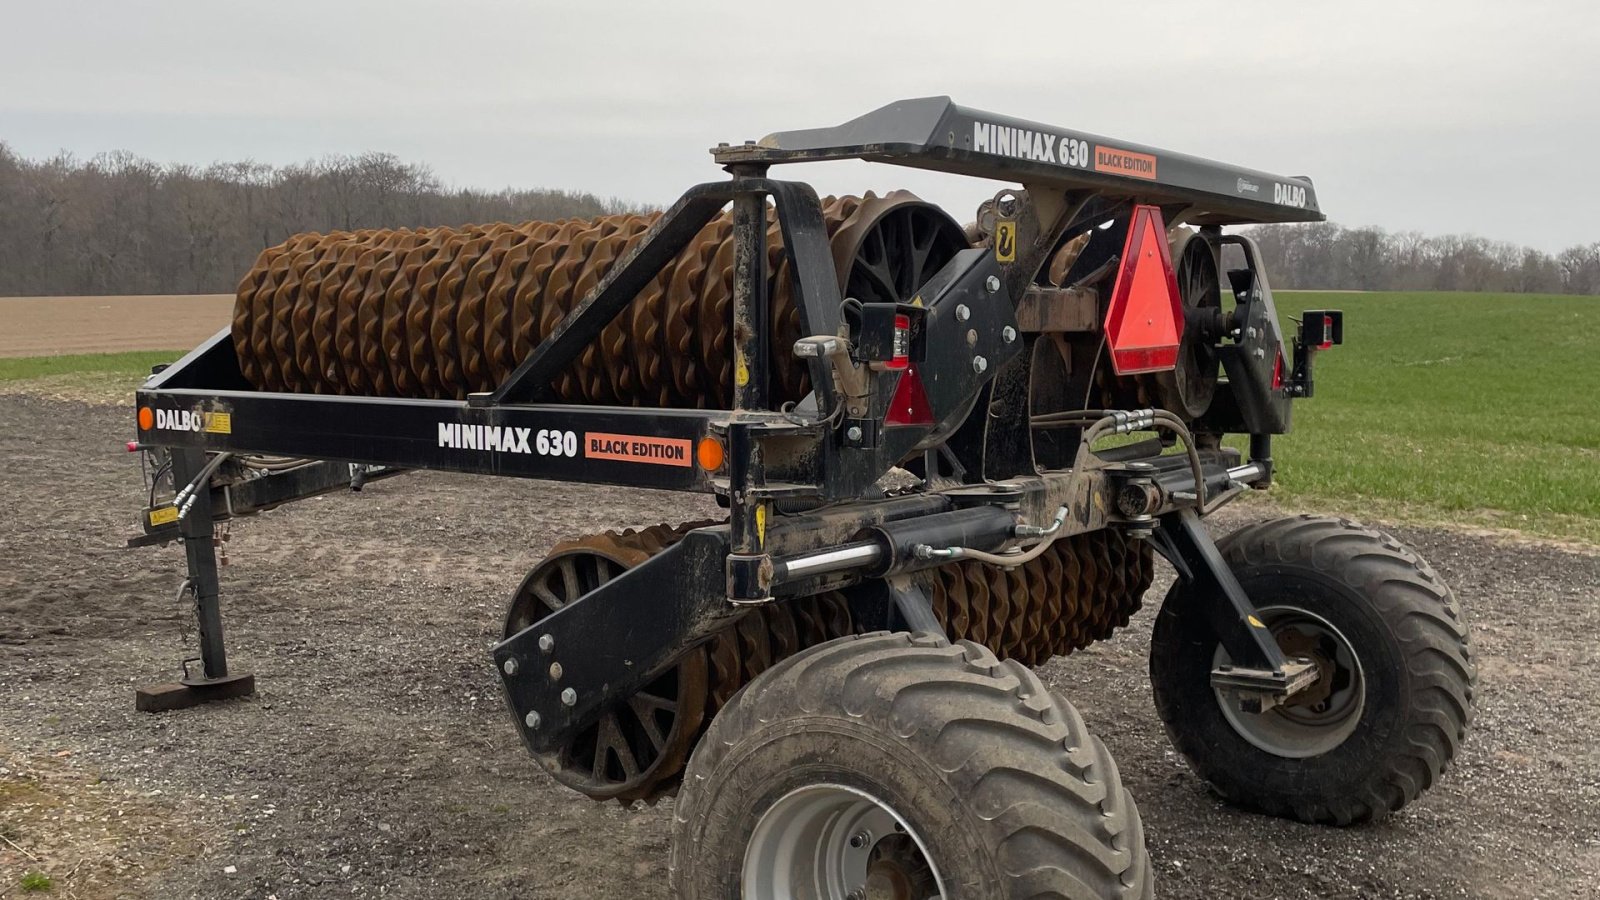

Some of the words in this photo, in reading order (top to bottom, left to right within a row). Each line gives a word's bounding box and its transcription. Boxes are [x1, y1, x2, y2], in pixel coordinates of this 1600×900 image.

[974, 121, 1056, 163] MINIMAX
[1058, 137, 1089, 168] 630
[1098, 152, 1122, 168] BLACK
[1124, 156, 1153, 173] EDITION
[1274, 182, 1306, 208] DALBO
[438, 422, 532, 454] MINIMAX
[536, 429, 577, 458] 630
[591, 438, 629, 455] BLACK
[632, 442, 684, 460] EDITION
